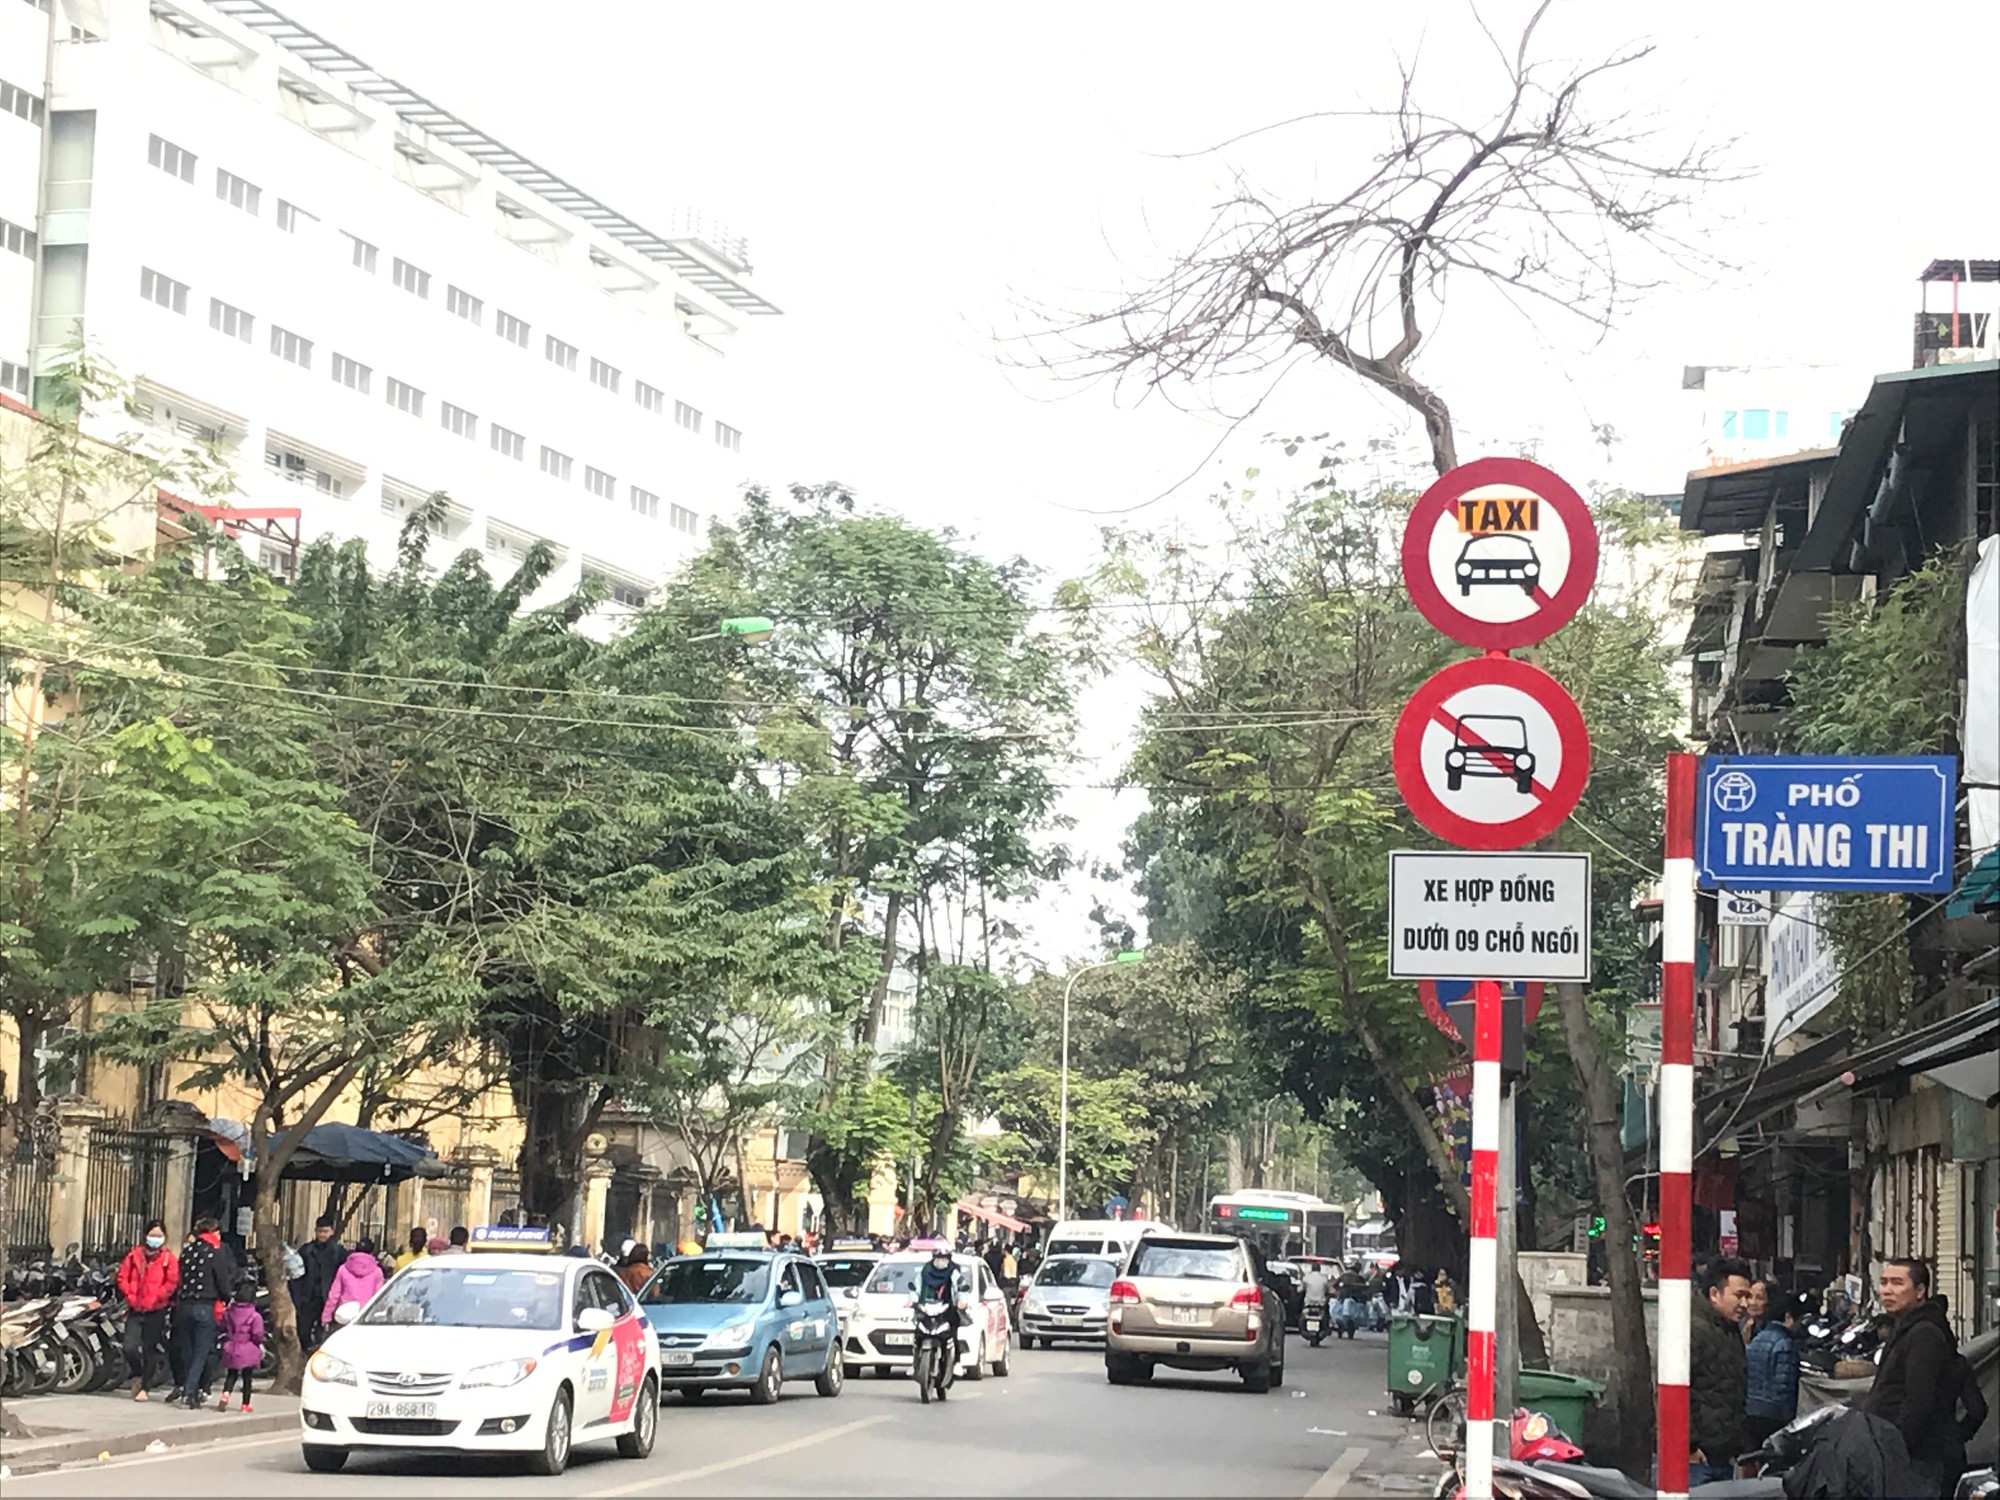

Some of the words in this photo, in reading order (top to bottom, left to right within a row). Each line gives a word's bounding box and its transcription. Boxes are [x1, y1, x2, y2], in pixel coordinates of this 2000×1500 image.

[1460, 500, 1539, 531] TAXI
[1787, 773, 1864, 807] PHỐ
[1721, 812, 1851, 868] TRÀNG
[1865, 824, 1928, 868] THI
[1423, 879, 1448, 902] XE
[1454, 877, 1494, 908] HỢP
[1403, 922, 1449, 951] DƯỚI
[1455, 929, 1479, 952] 09
[1485, 921, 1525, 954] CHỖ
